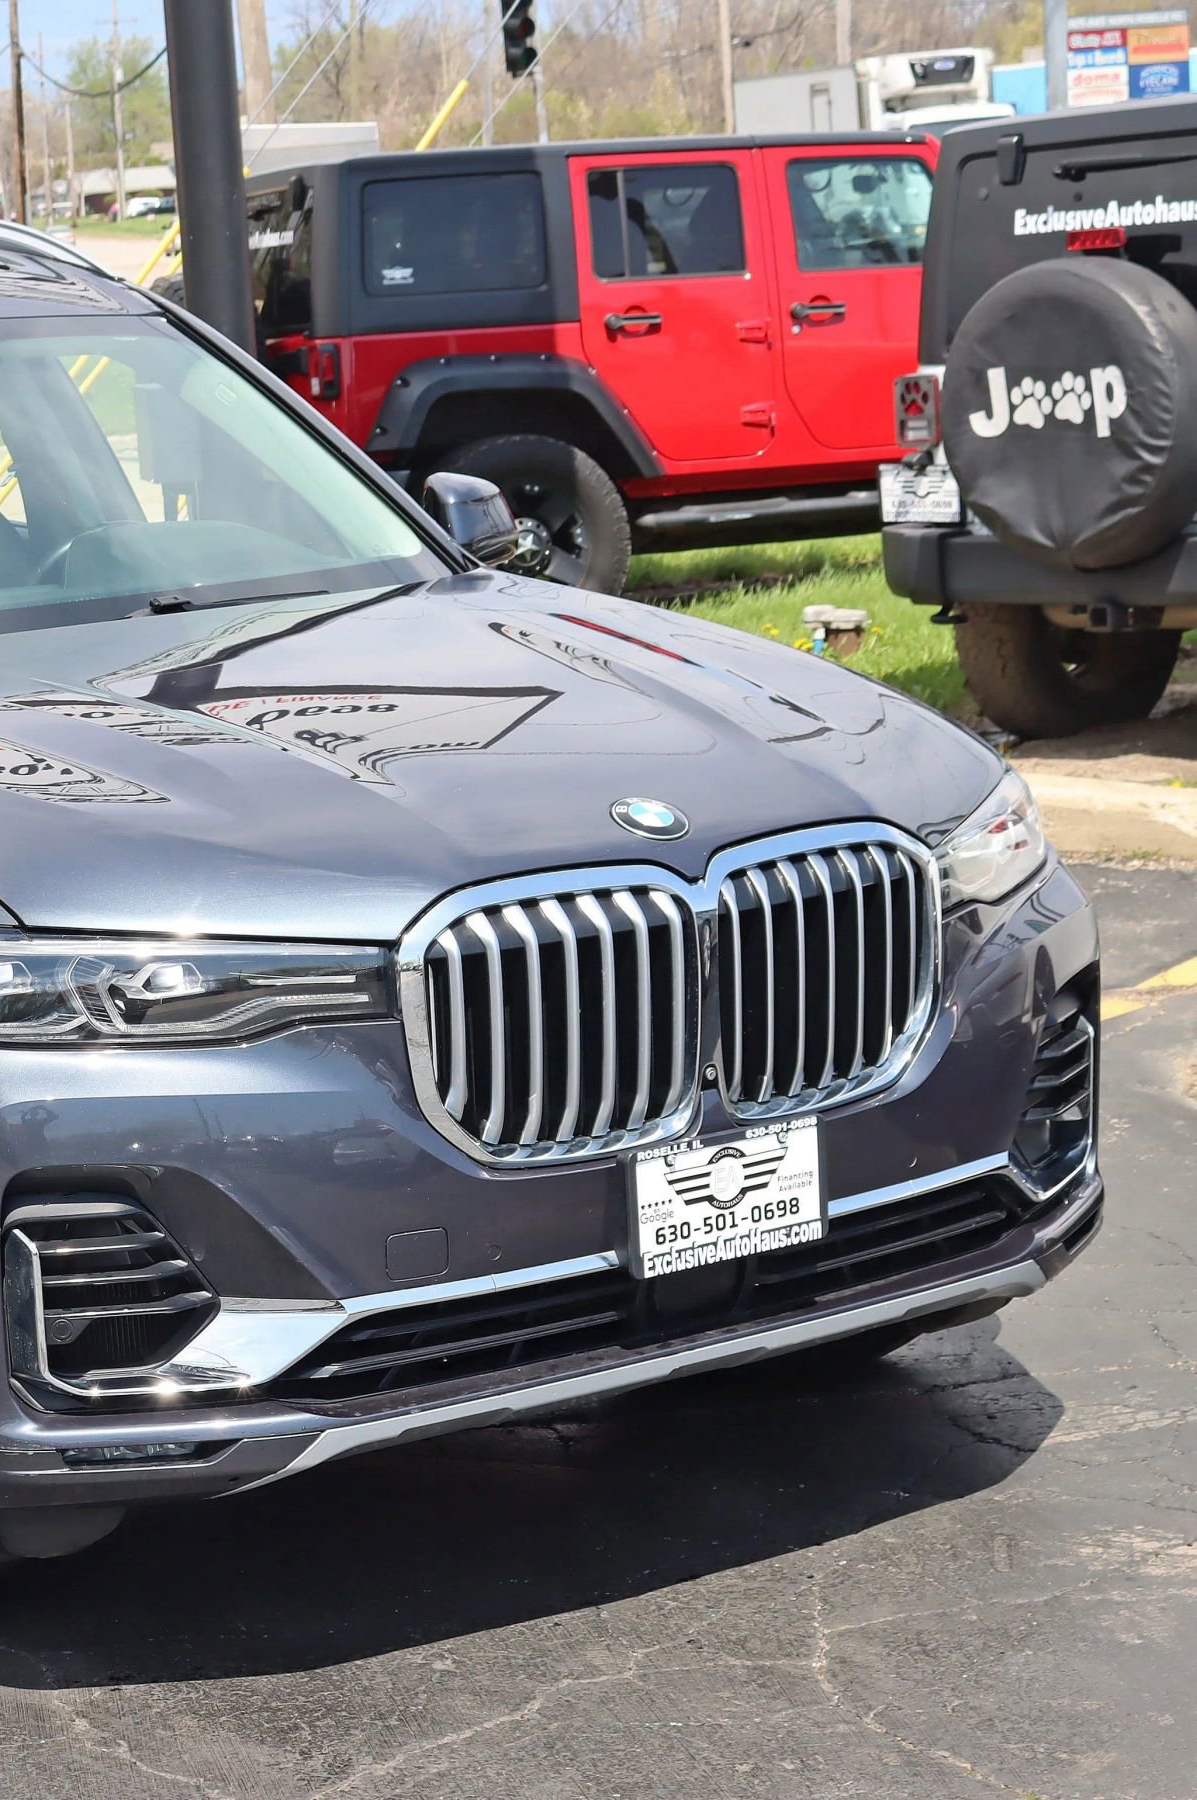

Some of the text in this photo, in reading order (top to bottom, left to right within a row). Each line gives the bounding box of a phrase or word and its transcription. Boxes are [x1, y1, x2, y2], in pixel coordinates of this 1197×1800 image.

[746, 1116, 818, 1139] 630-501-0698
[637, 1139, 704, 1162] ROSELLE, IL
[777, 1170, 814, 1183] Financing
[779, 1180, 813, 1192] Available
[712, 1194, 744, 1209] AUTOHAUS
[640, 1208, 674, 1225] Google
[655, 1197, 801, 1246] 630-501-0698
[643, 1220, 823, 1279] ExclusiveAutoHaus.com
